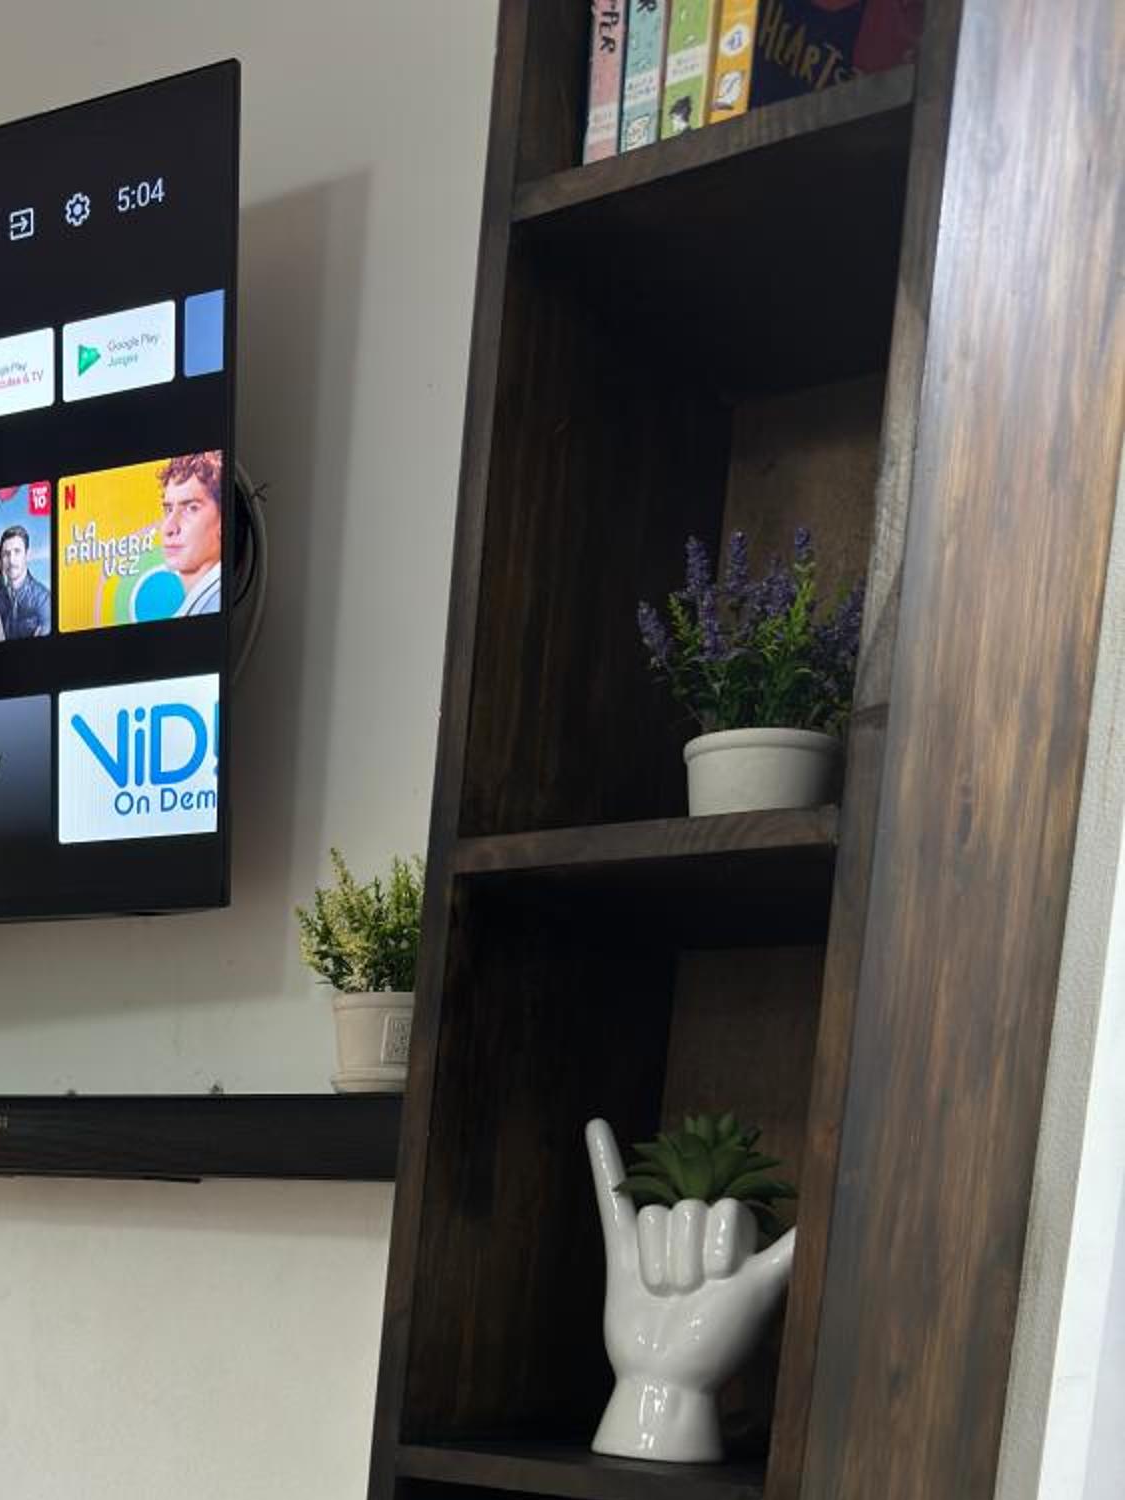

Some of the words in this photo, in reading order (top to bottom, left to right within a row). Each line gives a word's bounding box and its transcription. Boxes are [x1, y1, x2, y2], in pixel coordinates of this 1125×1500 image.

[117, 177, 165, 212] 5:04
[31, 368, 44, 382] TV
[33, 496, 46, 510] 10
[65, 484, 75, 511] N
[72, 520, 96, 543] LA
[65, 527, 156, 566] PRIMERA
[104, 554, 141, 579] VEZ
[71, 701, 219, 788] ViD
[114, 791, 149, 816] On
